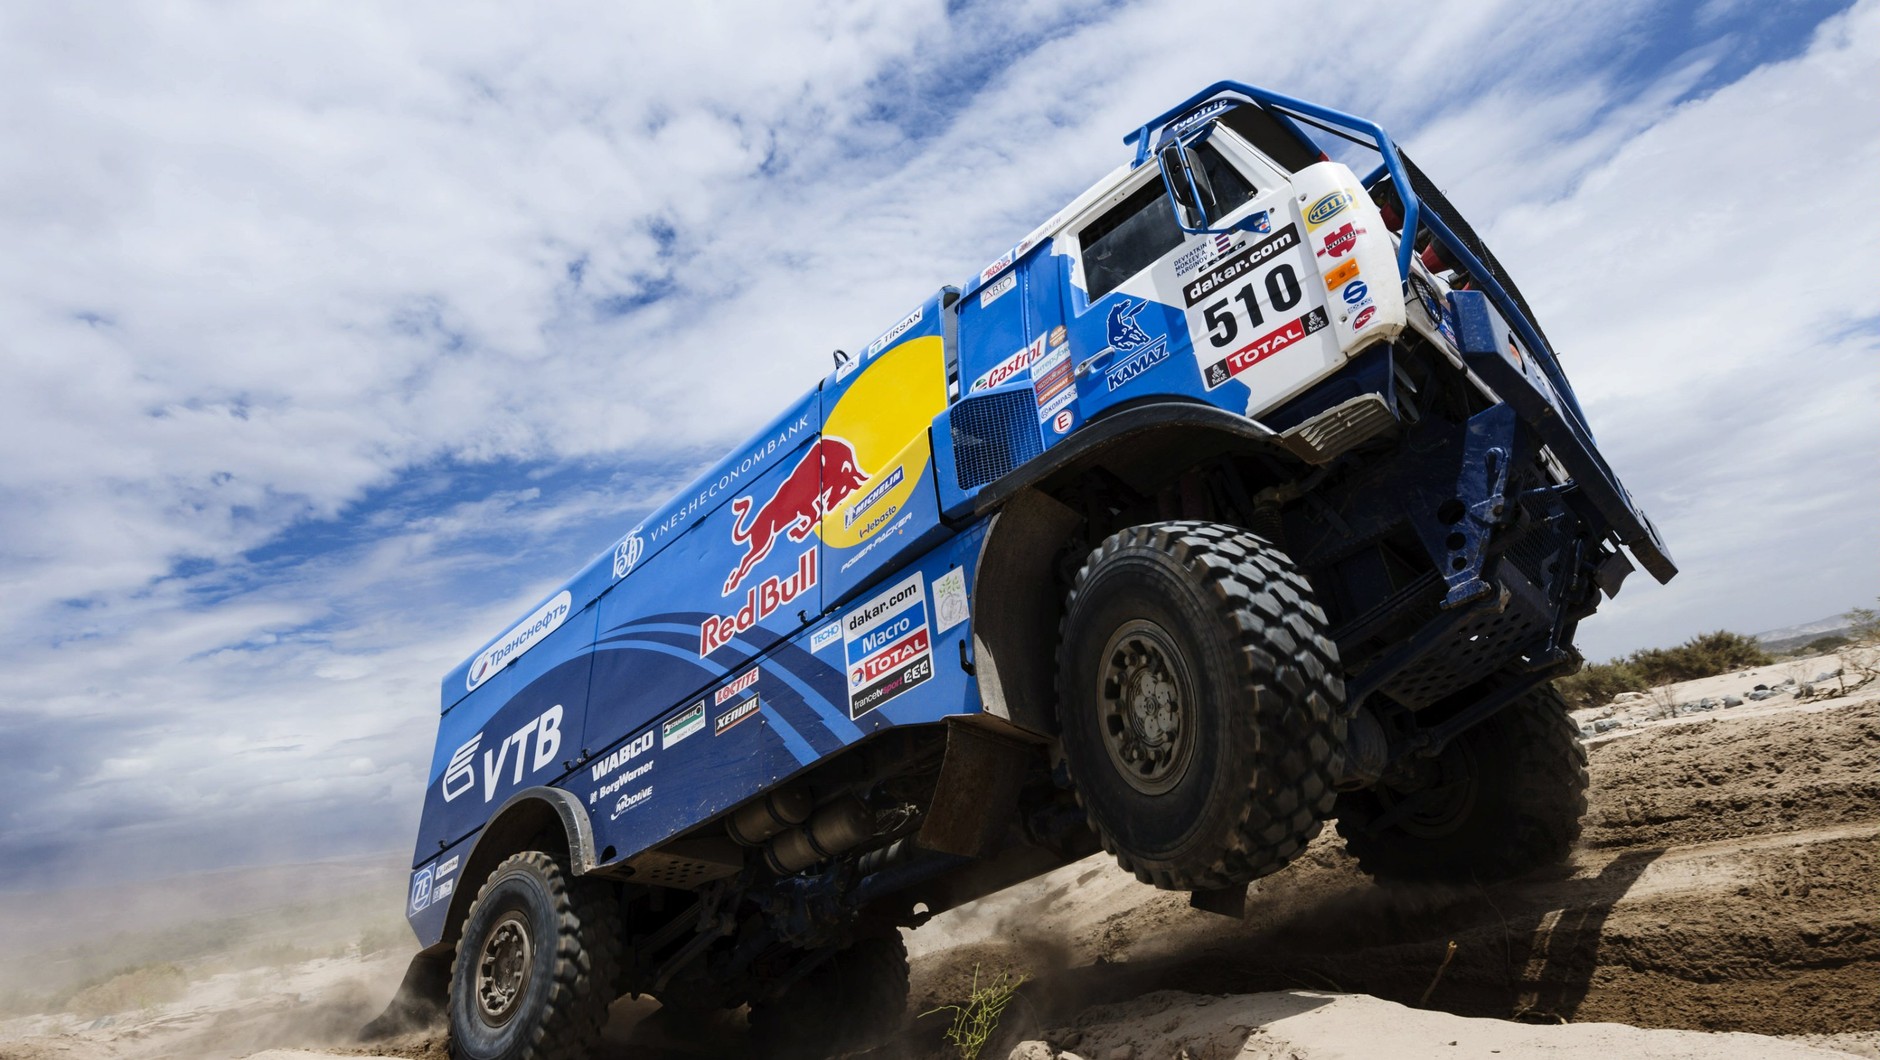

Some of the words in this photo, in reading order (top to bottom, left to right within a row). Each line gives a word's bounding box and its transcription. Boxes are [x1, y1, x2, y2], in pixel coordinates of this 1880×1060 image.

[1174, 243, 1207, 266] DEVYATKIN
[1175, 254, 1200, 272] MOKEEV
[1177, 257, 1208, 277] KARGINOV
[1190, 231, 1292, 299] dakar.com
[1203, 263, 1302, 348] 510
[883, 310, 921, 343] TIRSAN
[988, 339, 1043, 388] Castrol
[1106, 341, 1170, 392] KAMAZ
[1229, 329, 1302, 368] TOTAL
[1058, 413, 1069, 430] E
[650, 414, 809, 542] VNESHECONOMBANK
[855, 470, 901, 515] MICHELIN
[859, 505, 897, 538] Webasto
[840, 512, 912, 573] POWER-PACKER
[700, 586, 756, 660] Red
[759, 545, 817, 621] Bull
[849, 584, 917, 630] dakar.com
[490, 604, 567, 667] Транснефть
[813, 624, 839, 645] TECHO
[862, 618, 910, 654] Macro
[866, 639, 926, 675] TOTAL
[716, 669, 758, 704] LOCTITE
[484, 704, 563, 803] VTB
[592, 730, 654, 781] WABCO
[600, 760, 654, 798] BorgWarner
[616, 786, 653, 813] MODINE
[415, 874, 431, 904] ZF
